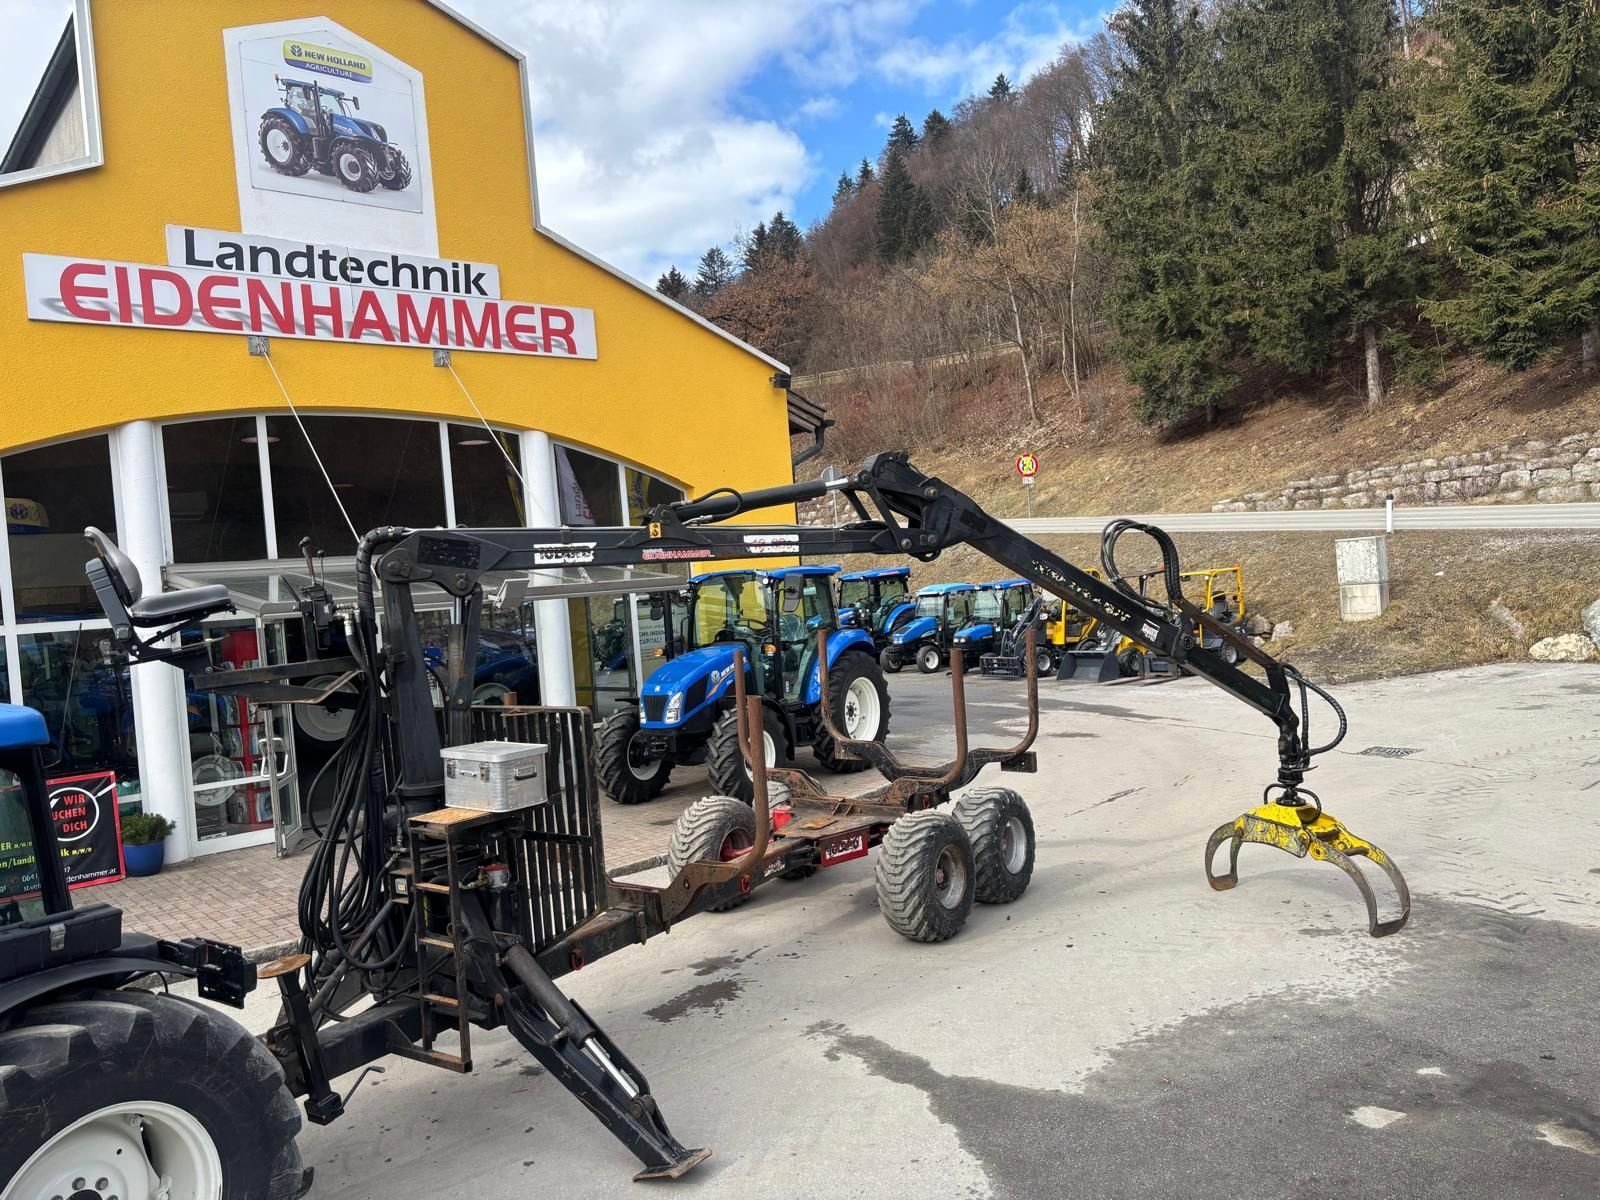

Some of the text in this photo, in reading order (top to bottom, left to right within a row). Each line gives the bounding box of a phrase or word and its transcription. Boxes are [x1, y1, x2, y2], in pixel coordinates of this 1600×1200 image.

[304, 50, 366, 70] NEW HOLLAND
[305, 63, 353, 78] AGRICULTURE
[184, 229, 489, 297] Landtechnik
[59, 263, 578, 355] EIDENHAMMER
[63, 793, 86, 806] WIR
[62, 820, 88, 833] DICH
